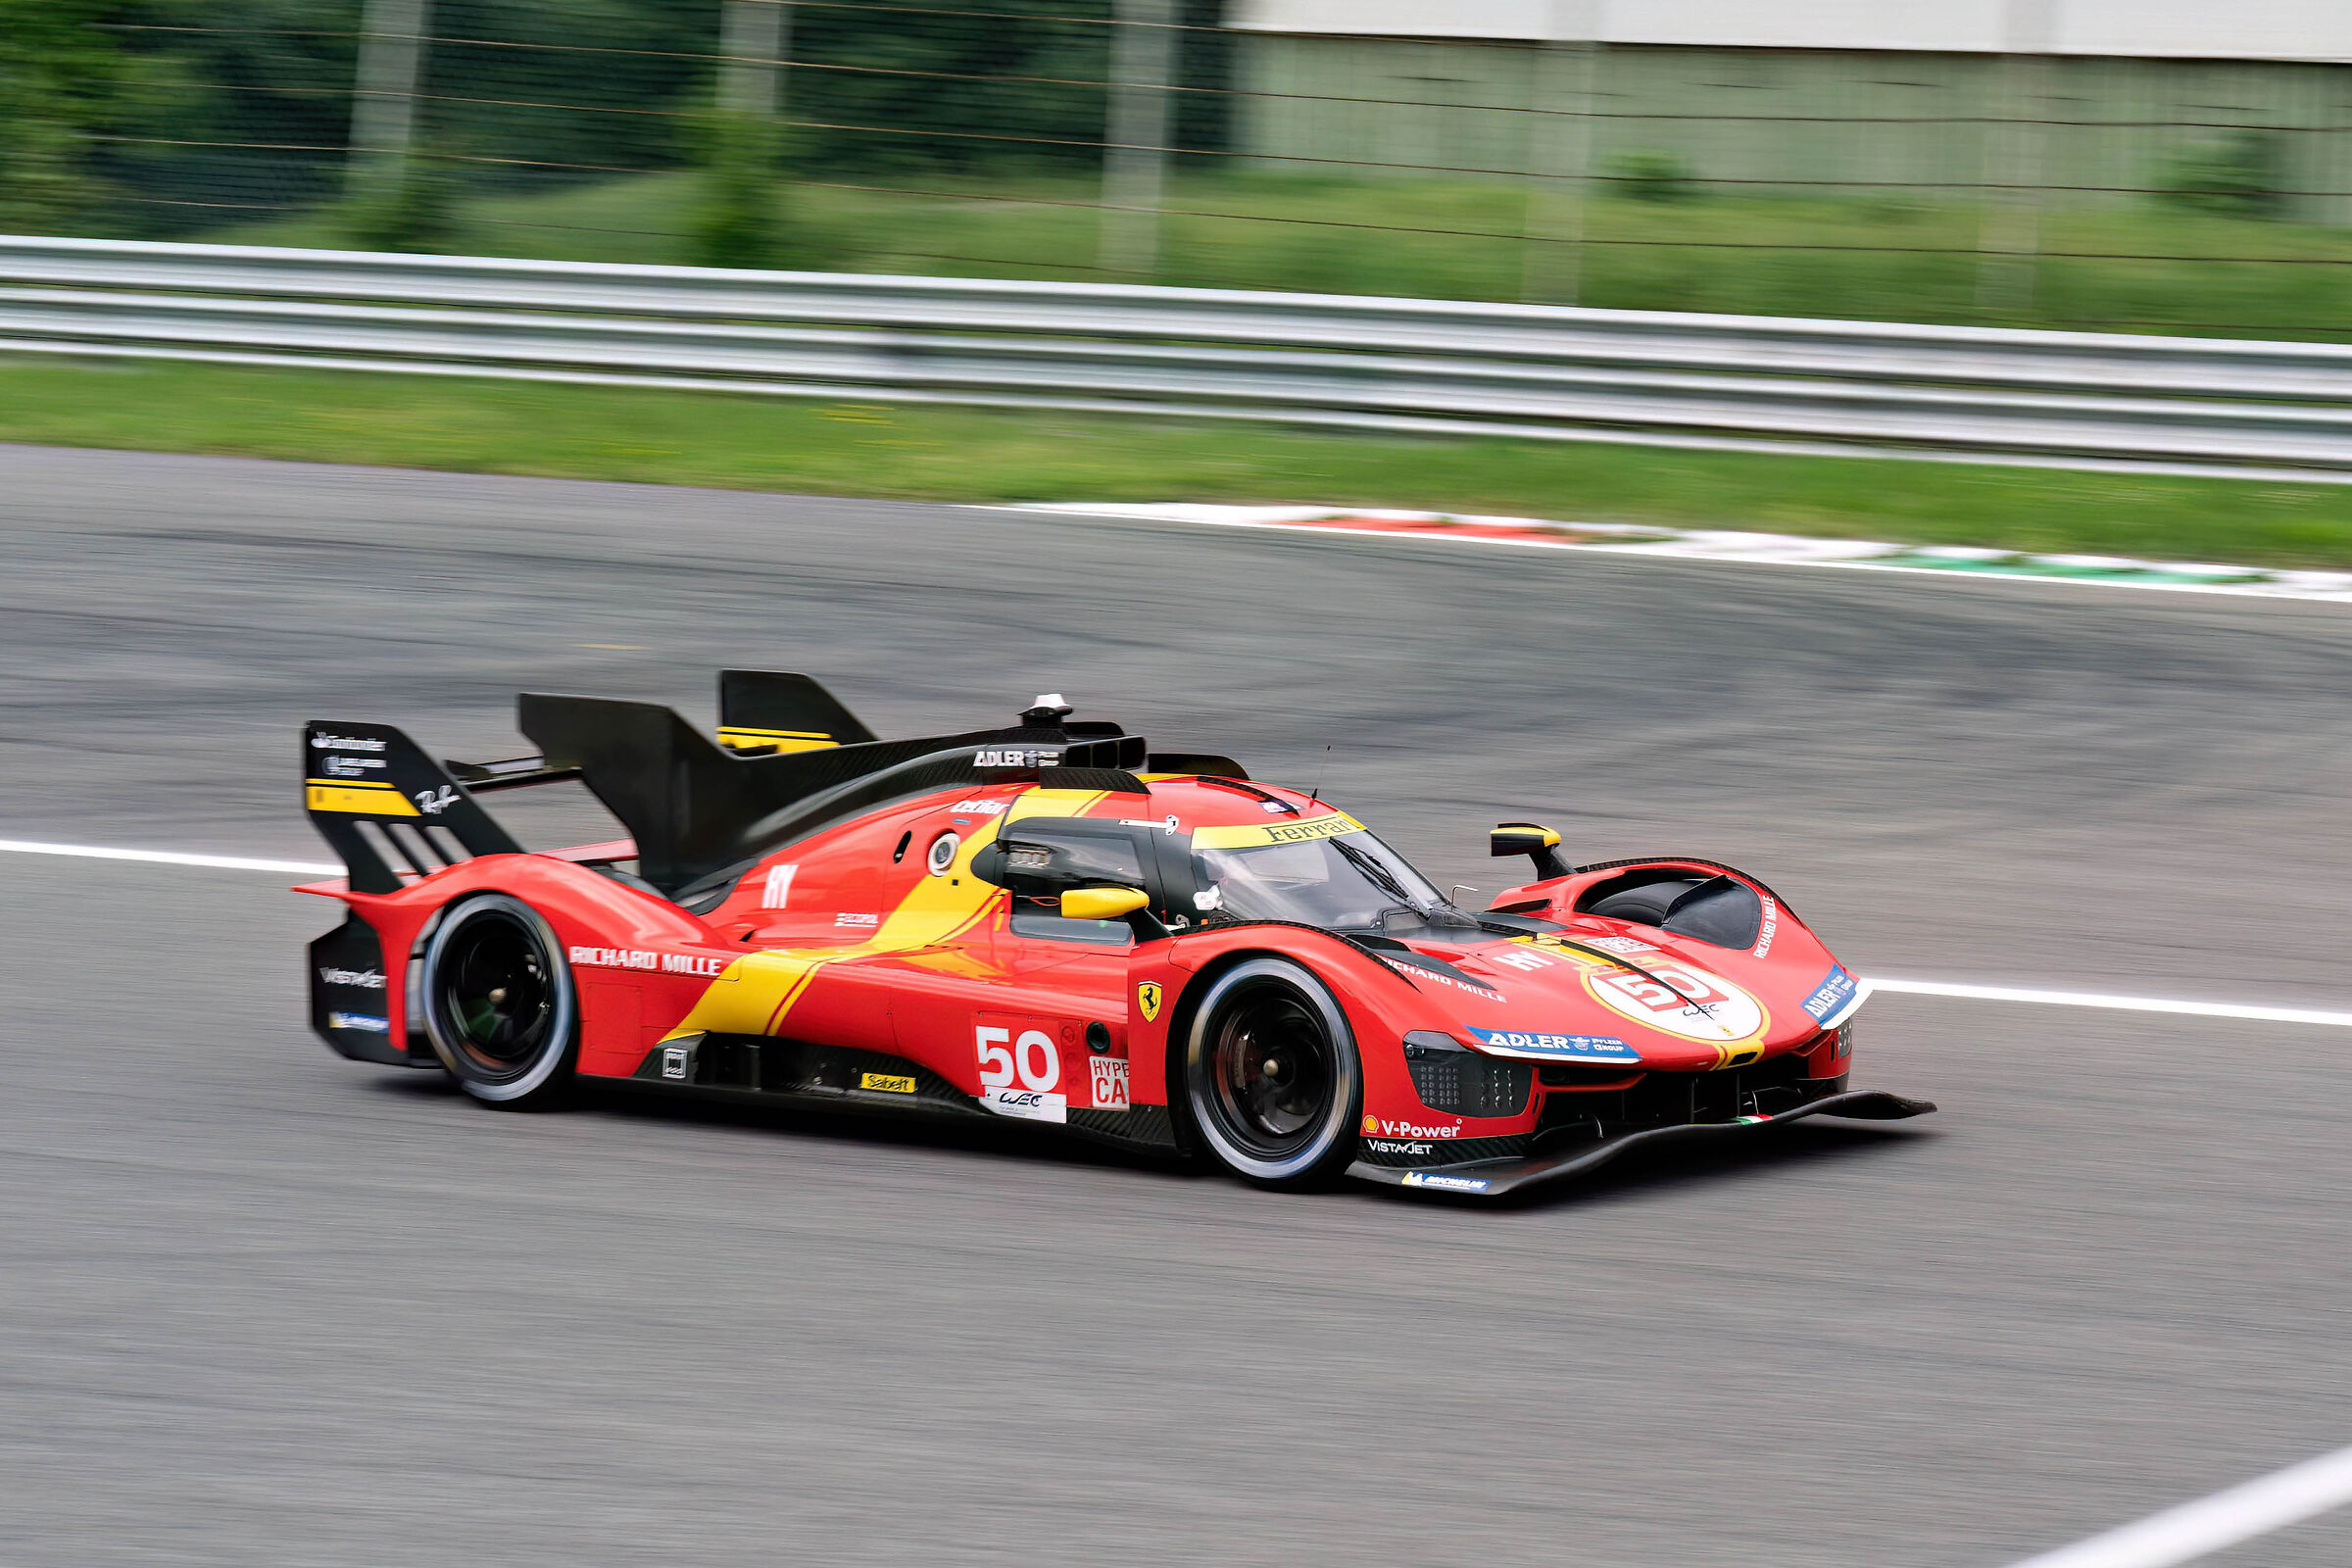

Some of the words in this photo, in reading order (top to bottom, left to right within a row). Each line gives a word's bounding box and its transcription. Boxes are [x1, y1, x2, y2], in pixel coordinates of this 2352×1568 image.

[972, 751, 1026, 767] ADLER
[1762, 895, 1777, 921] MILLE
[1753, 921, 1777, 959] RICHARD
[569, 947, 658, 969] RICHARD
[661, 954, 722, 976] MILLE
[1457, 982, 1507, 1004] MILLE
[1607, 970, 1711, 1006] 50
[1804, 988, 1841, 1018] ADLER
[1489, 1032, 1570, 1050] ADLER
[976, 1026, 1060, 1093] 50
[1093, 1059, 1130, 1077] HYPE
[999, 1092, 1043, 1107] WEC
[1096, 1077, 1128, 1104] CA
